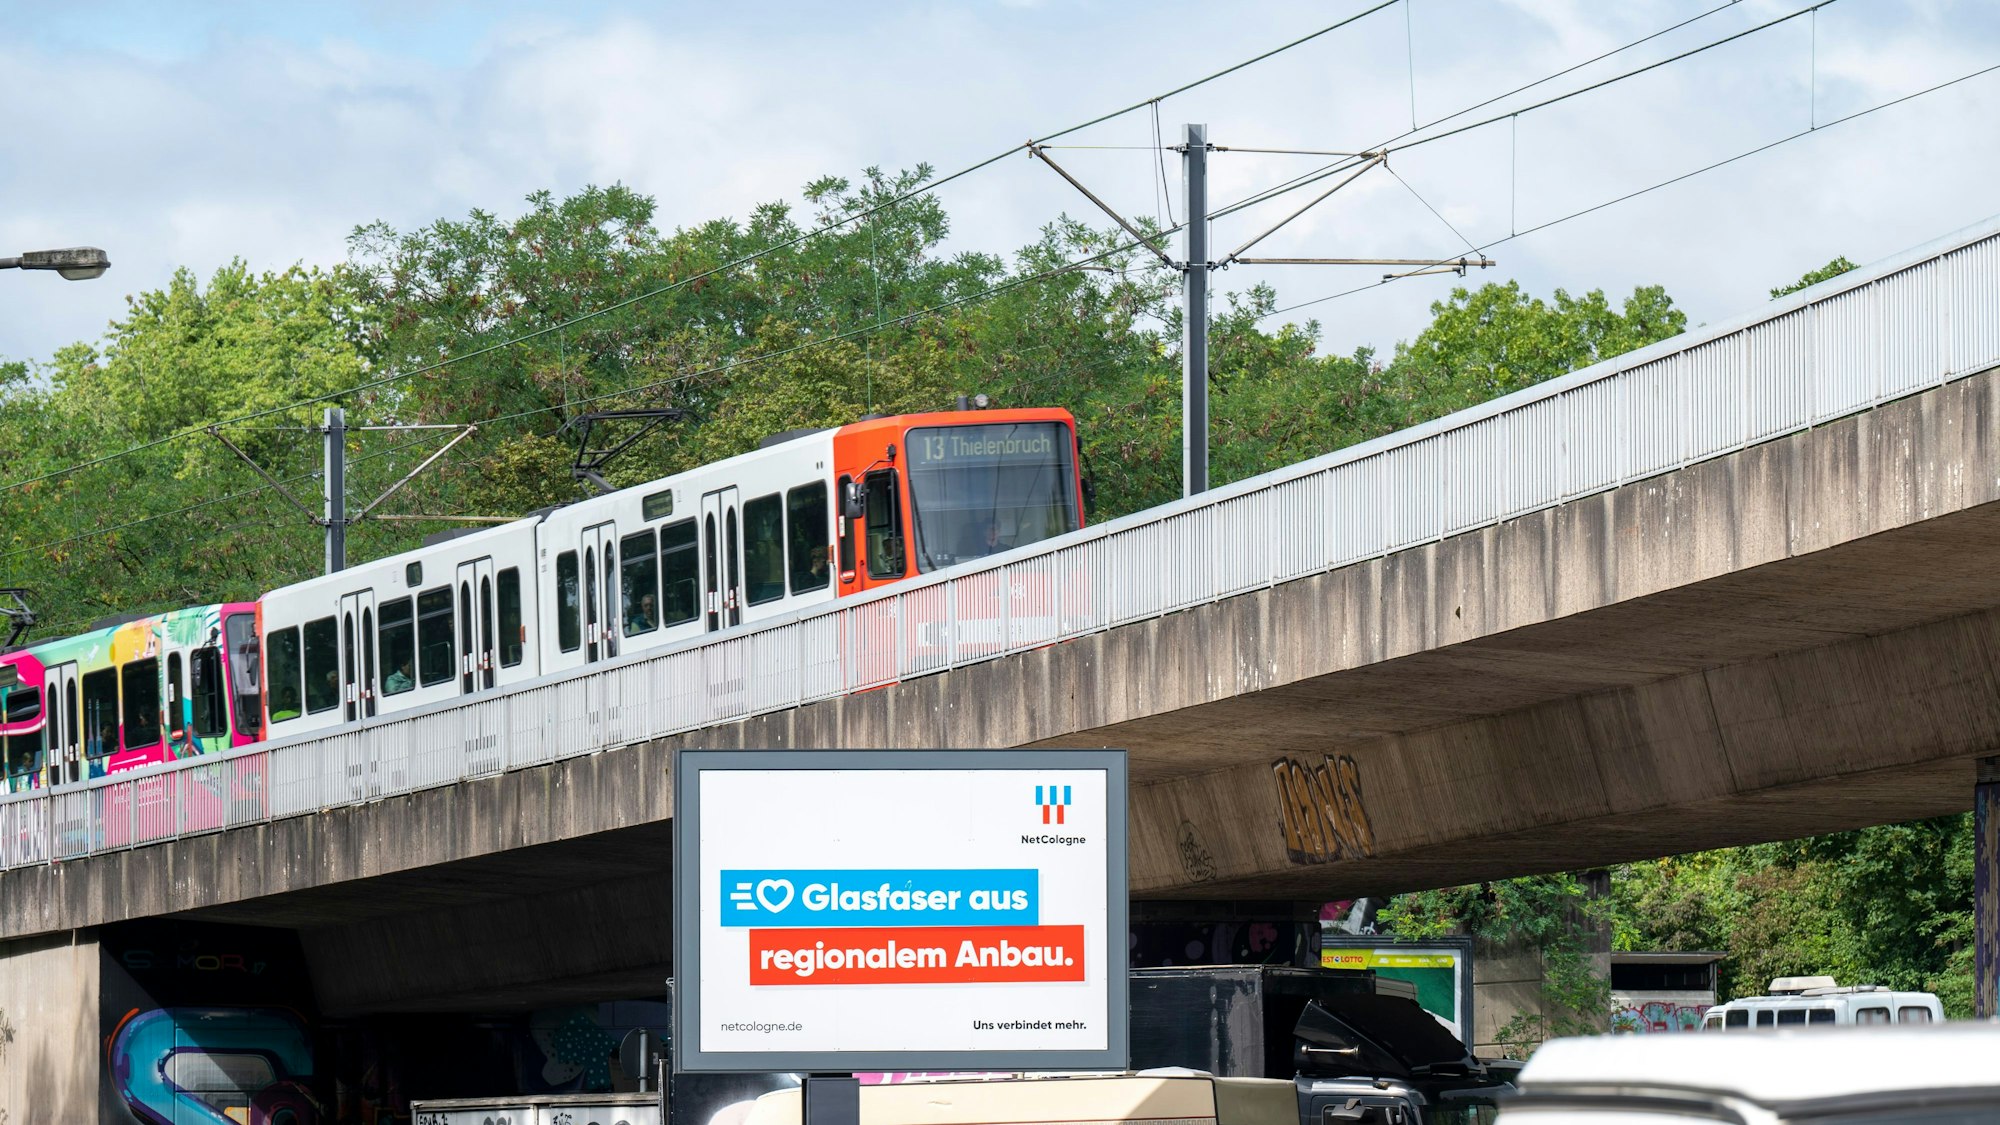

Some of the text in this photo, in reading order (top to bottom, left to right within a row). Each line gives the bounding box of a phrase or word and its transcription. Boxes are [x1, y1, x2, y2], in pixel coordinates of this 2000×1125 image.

[923, 433, 1051, 461] 13 Thielenbruch
[1020, 834, 1087, 846] NetCologne
[801, 881, 1029, 912] Glasfaser aus
[760, 938, 1075, 977] regionalem Anbau.
[720, 1020, 803, 1033] netcologne.de
[973, 1019, 1088, 1030] Uns verbindet mehr.
